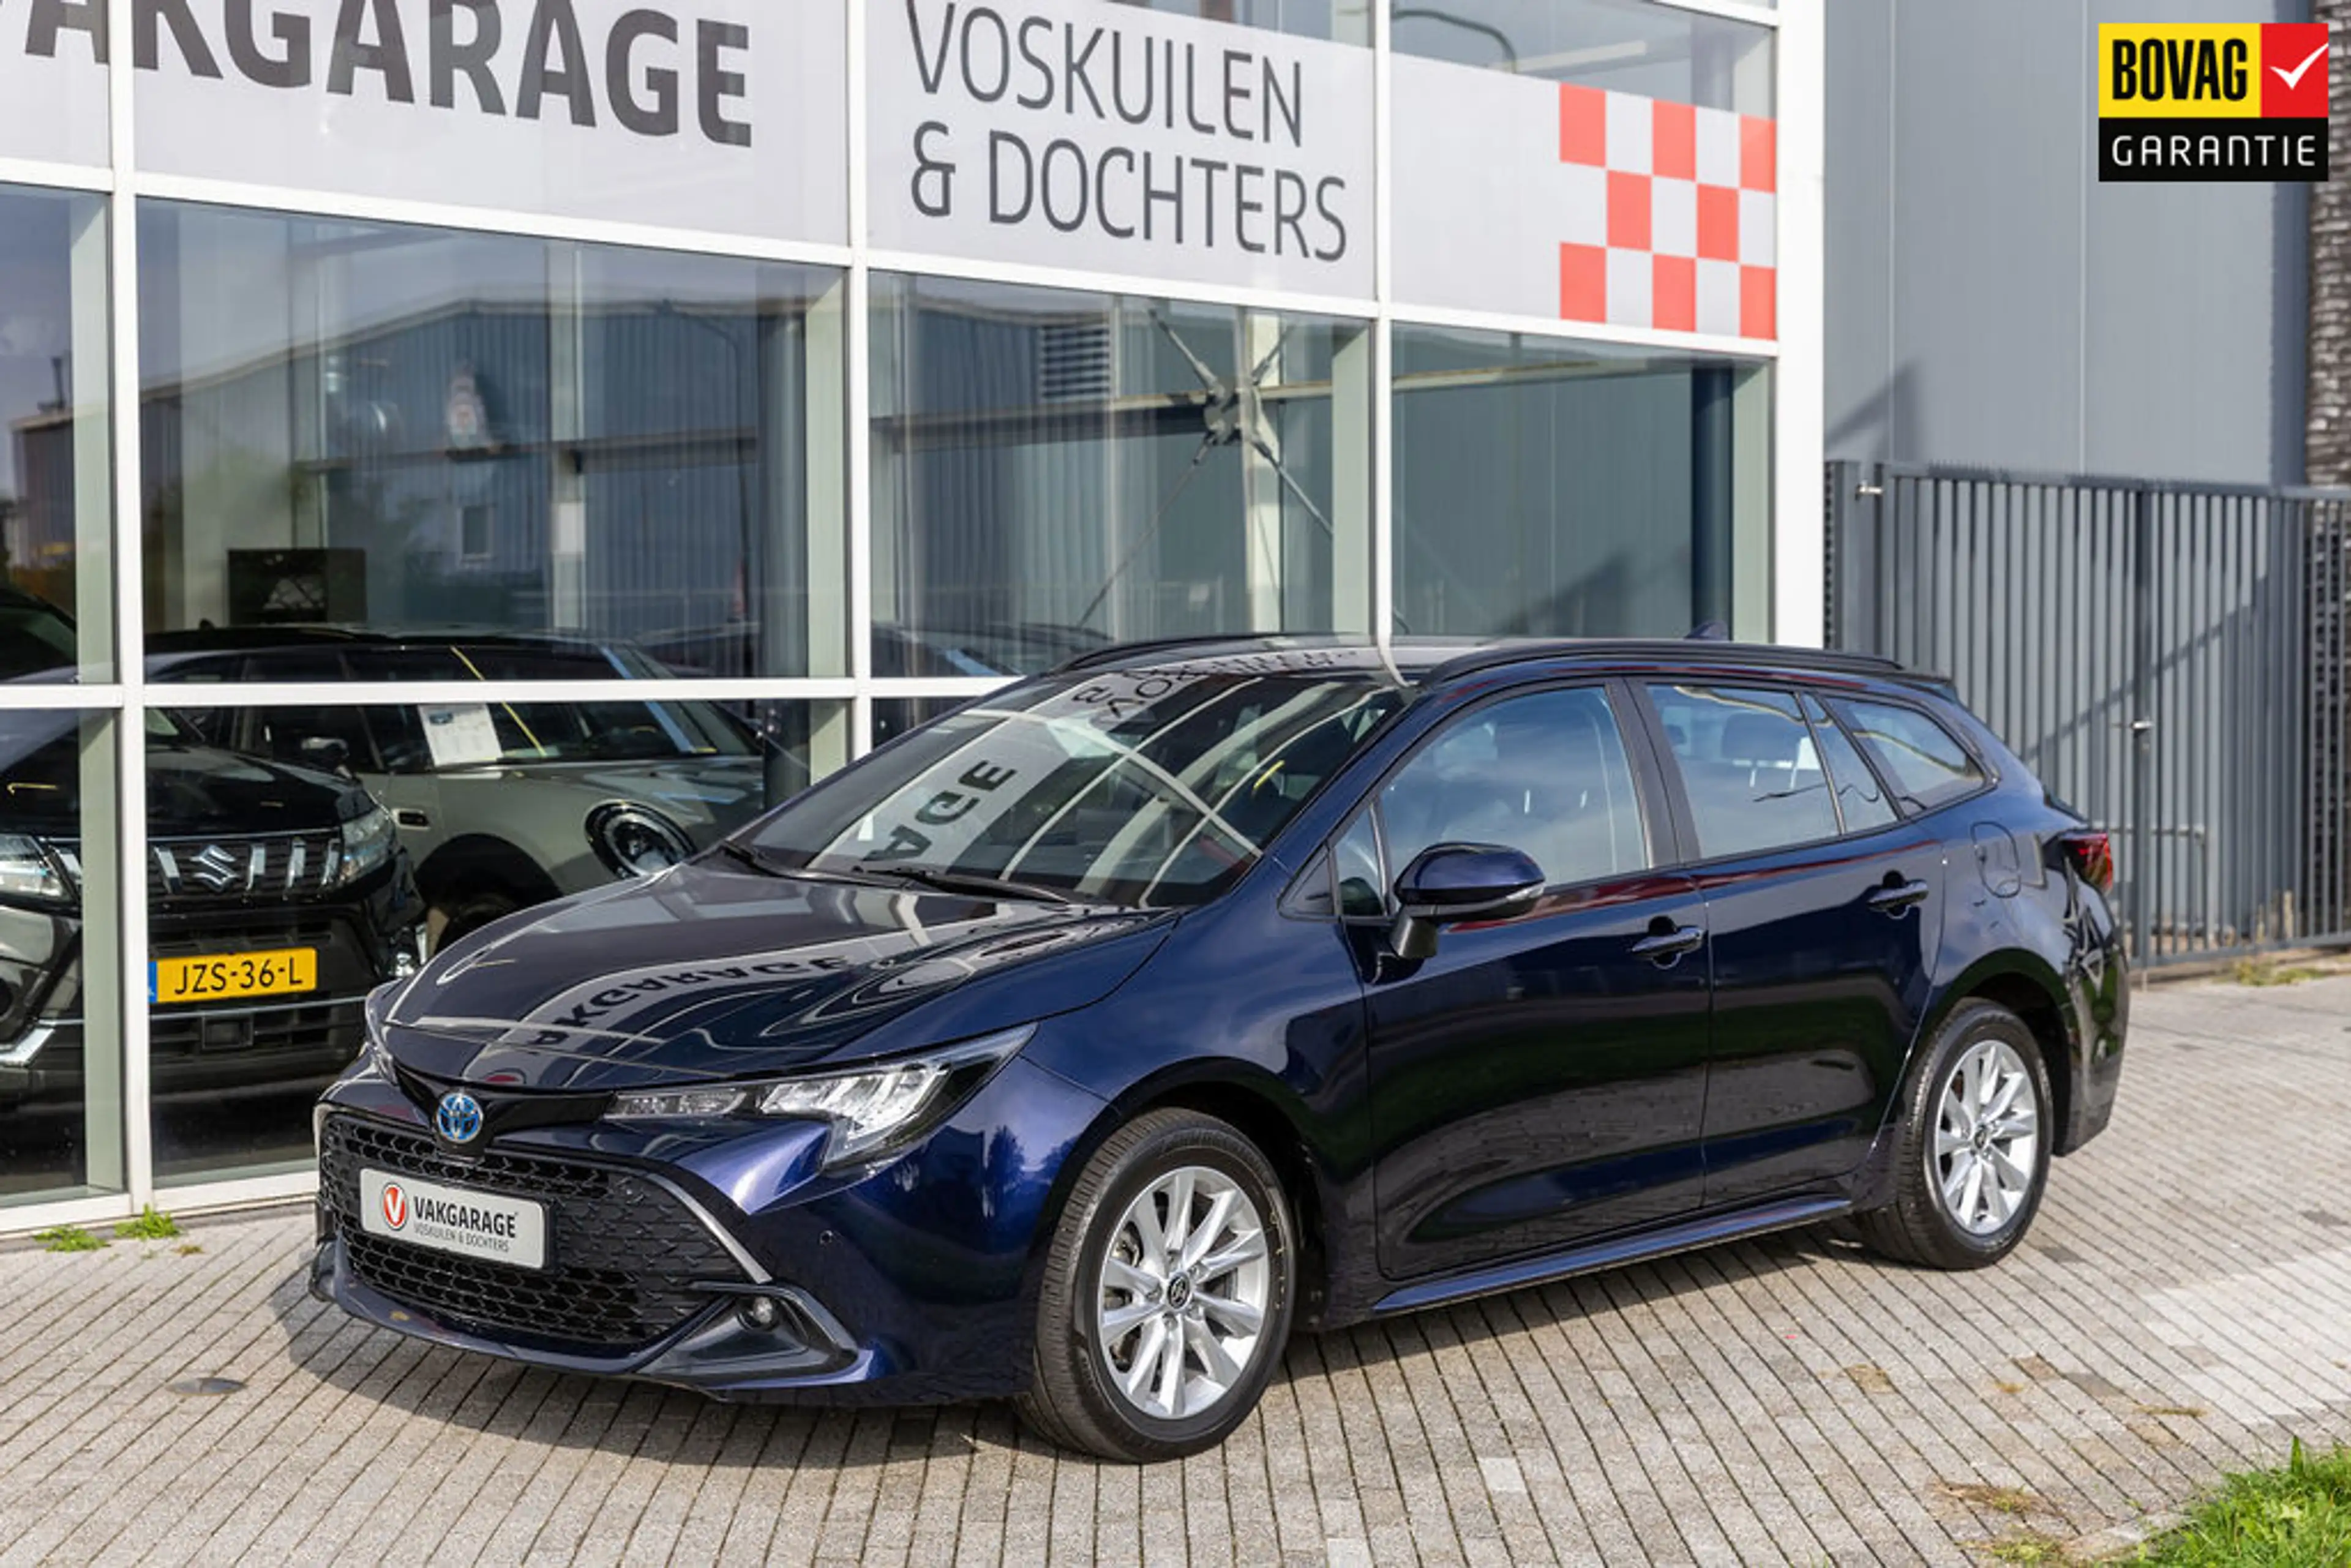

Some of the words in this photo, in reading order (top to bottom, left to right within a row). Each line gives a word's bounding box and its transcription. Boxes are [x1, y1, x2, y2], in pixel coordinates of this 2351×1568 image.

[906, 0, 1302, 148] VOSKUILEN
[910, 121, 956, 217] &
[989, 129, 1348, 261] DOCHTERS
[174, 956, 303, 995] JZS-36-L
[414, 1196, 516, 1238] VAKGARAGE
[466, 1233, 509, 1253] DOCHTERS
